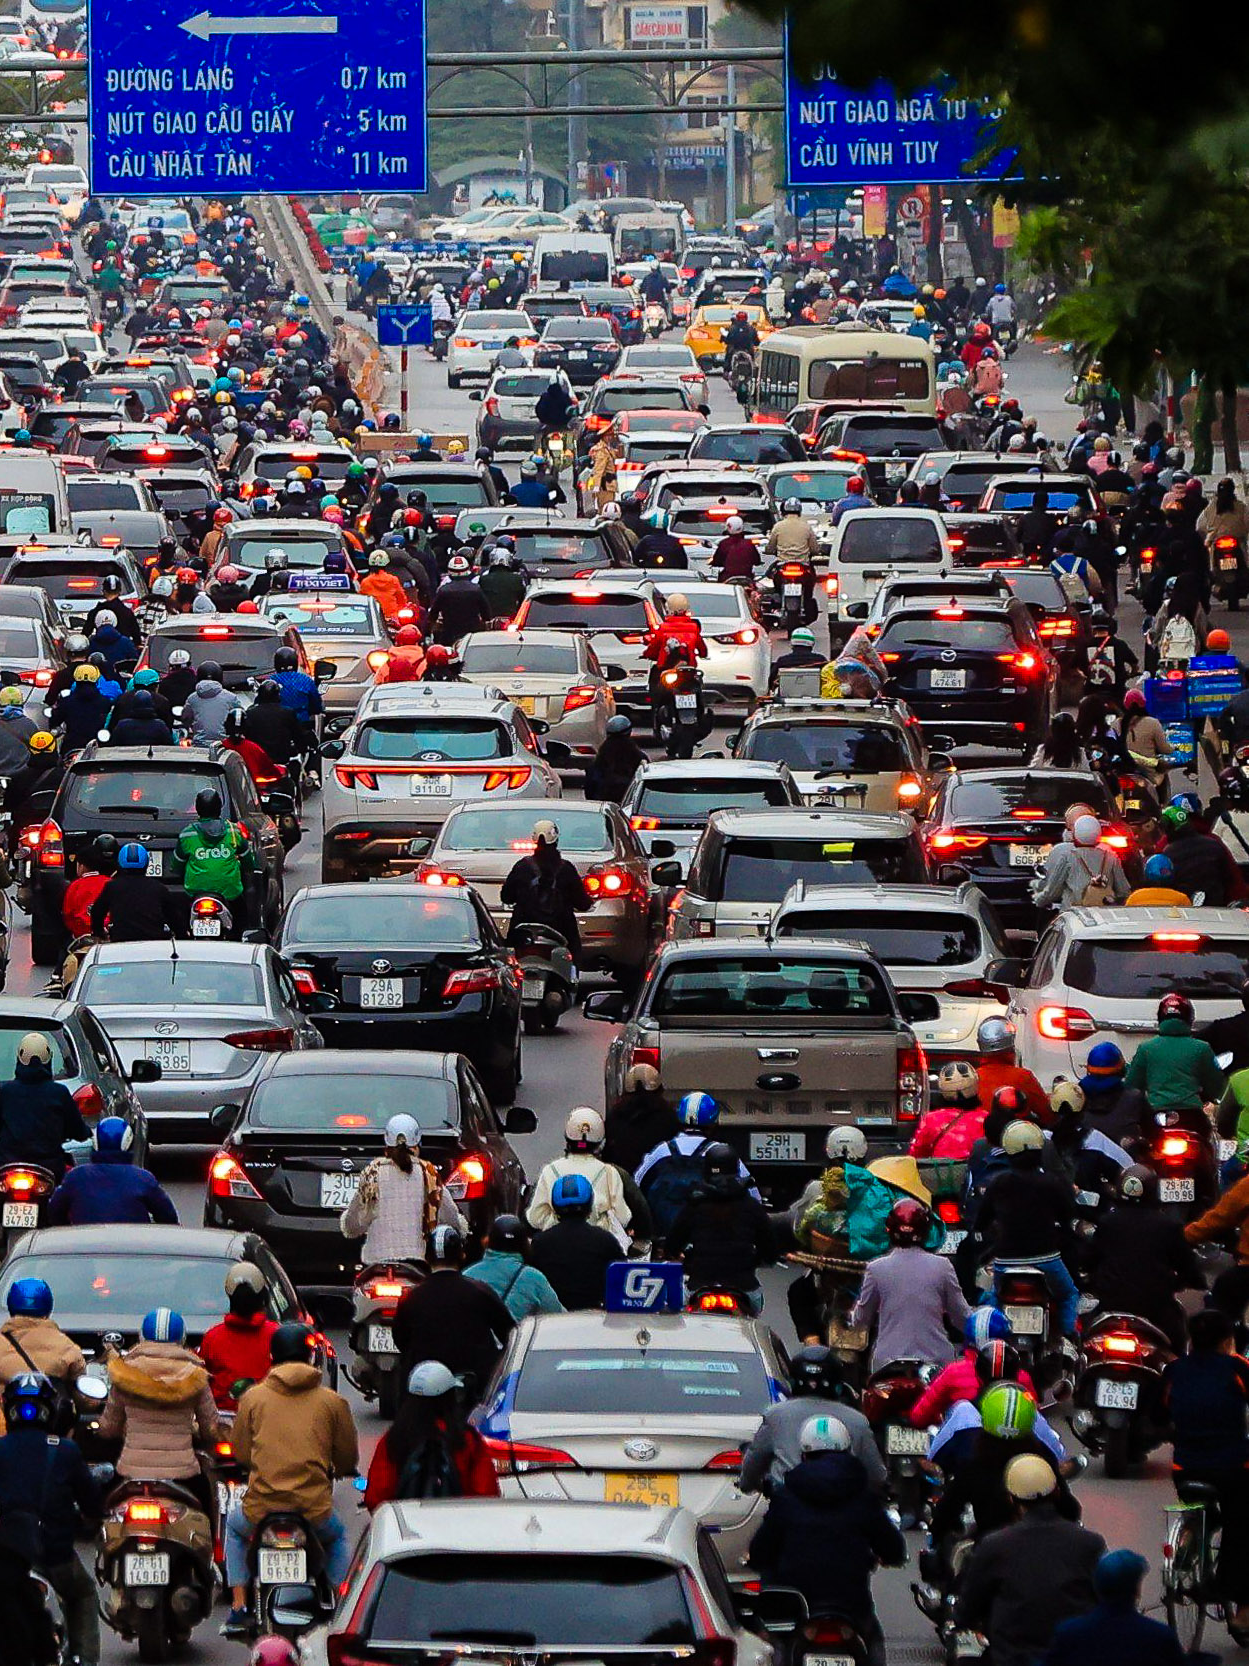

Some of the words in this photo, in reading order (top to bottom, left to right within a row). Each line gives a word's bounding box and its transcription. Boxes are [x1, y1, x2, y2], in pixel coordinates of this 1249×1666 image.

[107, 62, 173, 92] ĐƯỜNG
[182, 61, 234, 92] LÁNG
[378, 66, 407, 89] km
[107, 104, 145, 135] NÚT
[153, 112, 196, 134] GIAO
[206, 103, 242, 134] CẦU
[252, 102, 295, 133] GIẤY
[358, 110, 370, 132] 5
[378, 109, 407, 132] km
[800, 94, 837, 124] NÚT
[845, 100, 888, 123] GIAO
[896, 93, 934, 122] NGÃ
[801, 136, 838, 167] CẦU
[848, 138, 893, 165] VĨNH
[902, 141, 939, 164] TUY
[108, 148, 145, 178] CẦU
[154, 149, 204, 180] NHẬT
[215, 149, 251, 177] TÂN
[352, 153, 369, 174] 11
[378, 152, 408, 174] km
[195, 844, 231, 860] Grab
[371, 980, 393, 992] 29A
[363, 993, 402, 1006] 812.82
[155, 1041, 179, 1054] 30F
[765, 1135, 790, 1147] 29H
[756, 1147, 800, 1160] 551.11
[626, 1268, 665, 1308] G7
